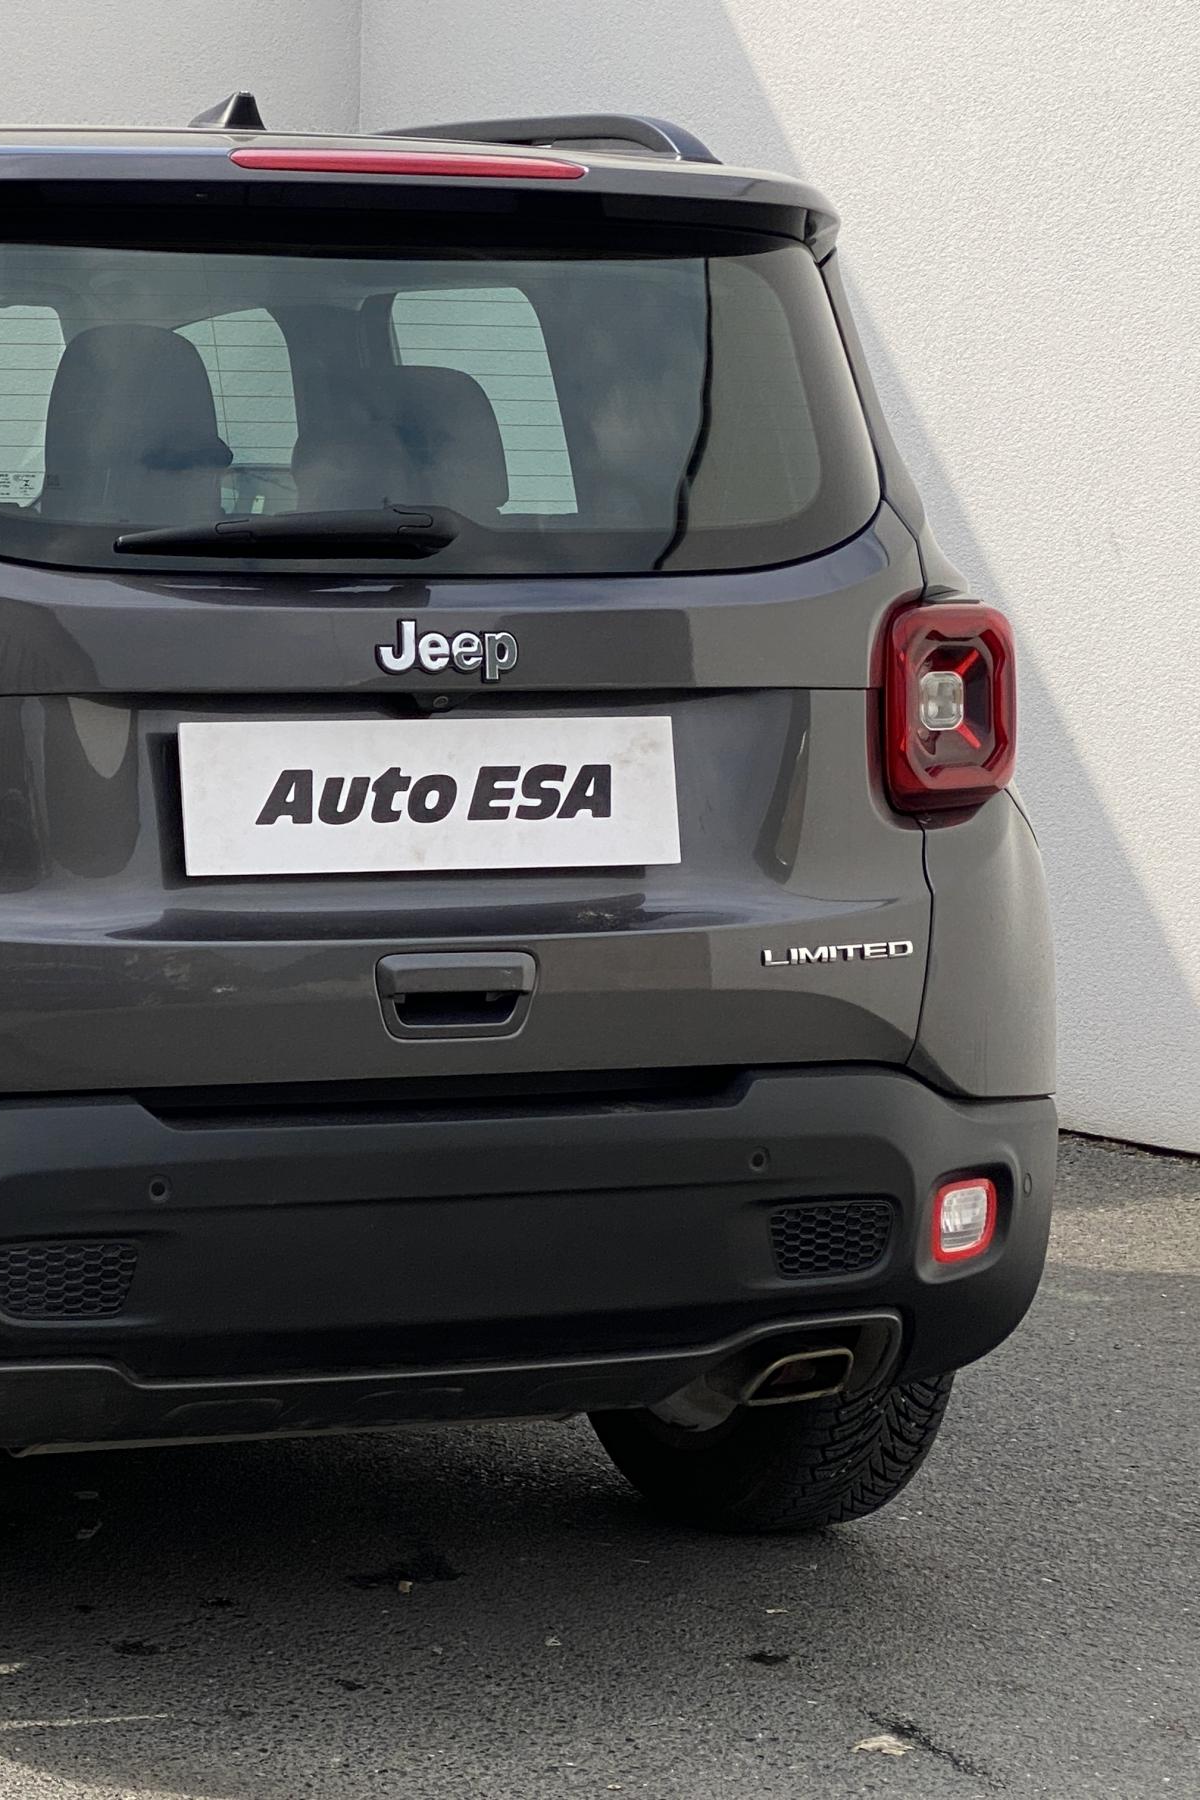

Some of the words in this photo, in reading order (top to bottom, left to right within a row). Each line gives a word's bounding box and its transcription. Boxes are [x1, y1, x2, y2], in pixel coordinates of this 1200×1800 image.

[376, 619, 518, 683] Jeep
[255, 766, 458, 826] Auto
[467, 763, 612, 821] ESA
[761, 940, 914, 967] LIMITED
